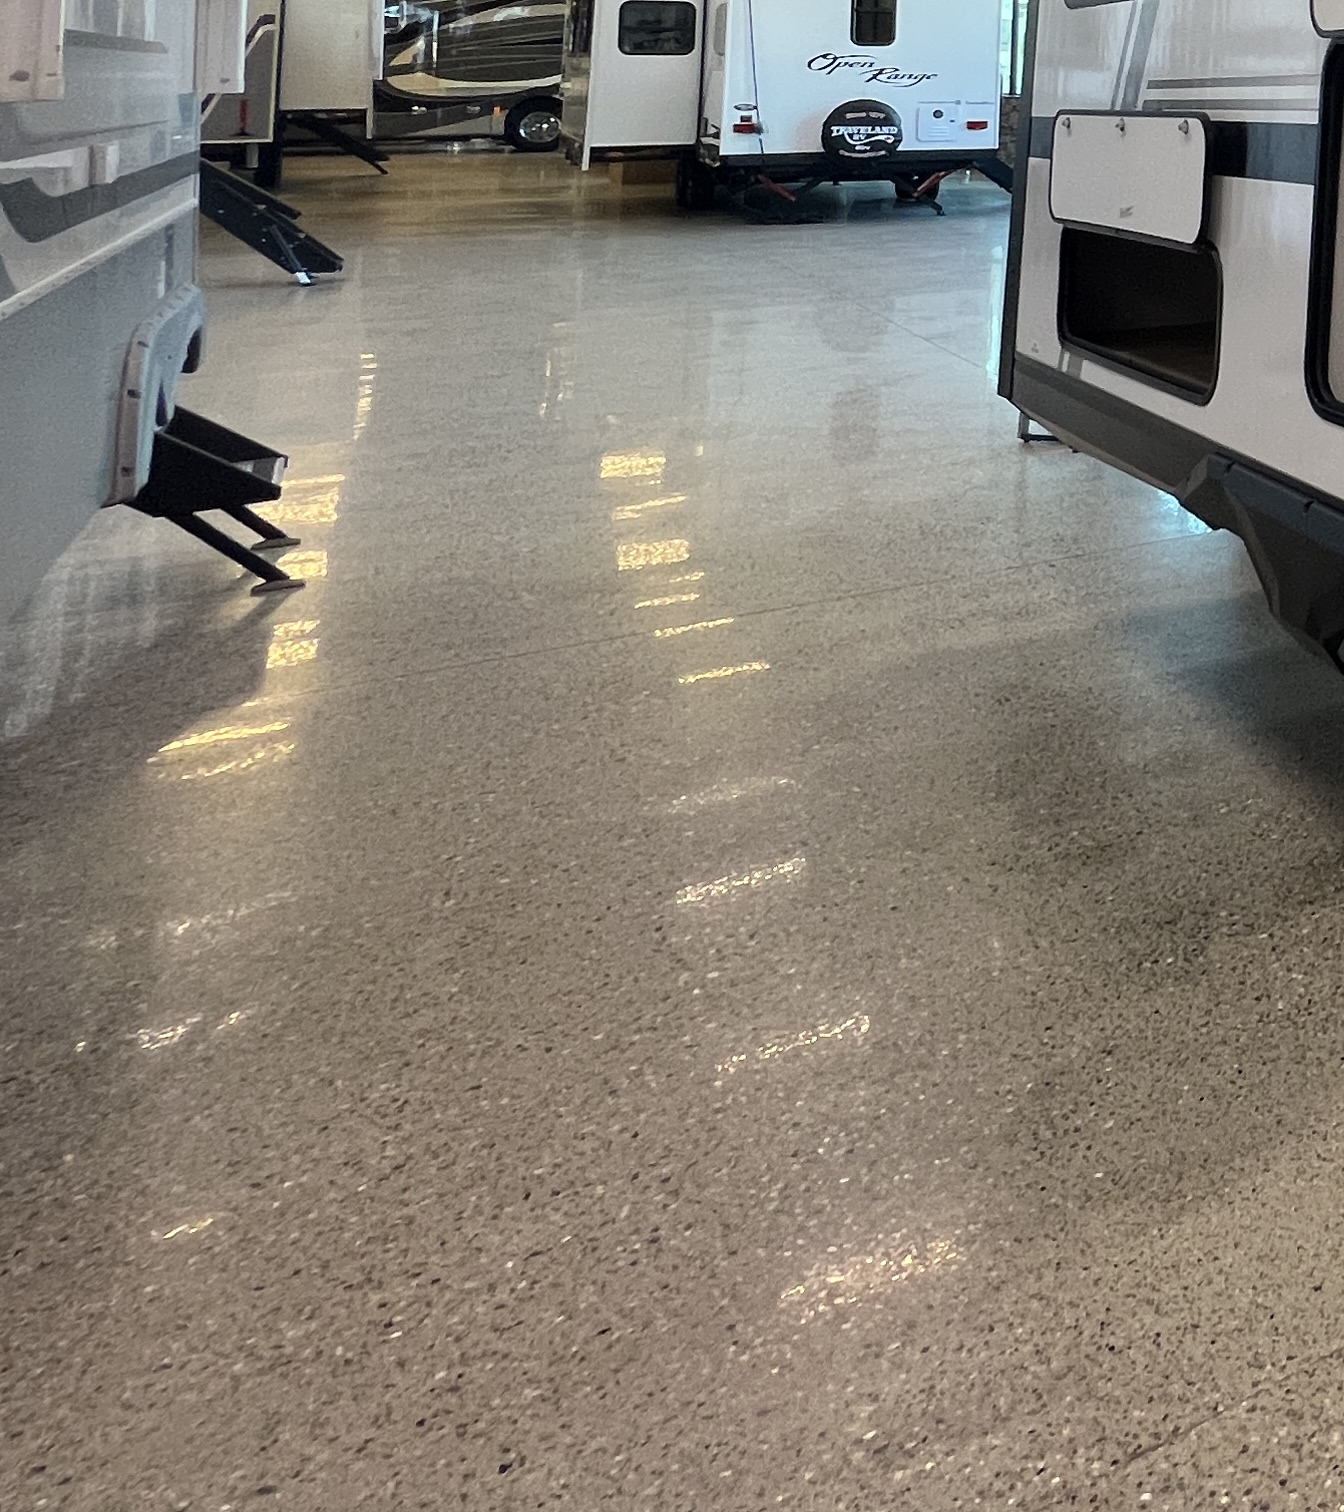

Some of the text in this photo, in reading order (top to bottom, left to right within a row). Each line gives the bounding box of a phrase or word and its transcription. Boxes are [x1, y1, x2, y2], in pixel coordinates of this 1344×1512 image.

[807, 53, 877, 75] Open
[859, 67, 938, 87] Range
[831, 125, 898, 137] TRAVELAND
